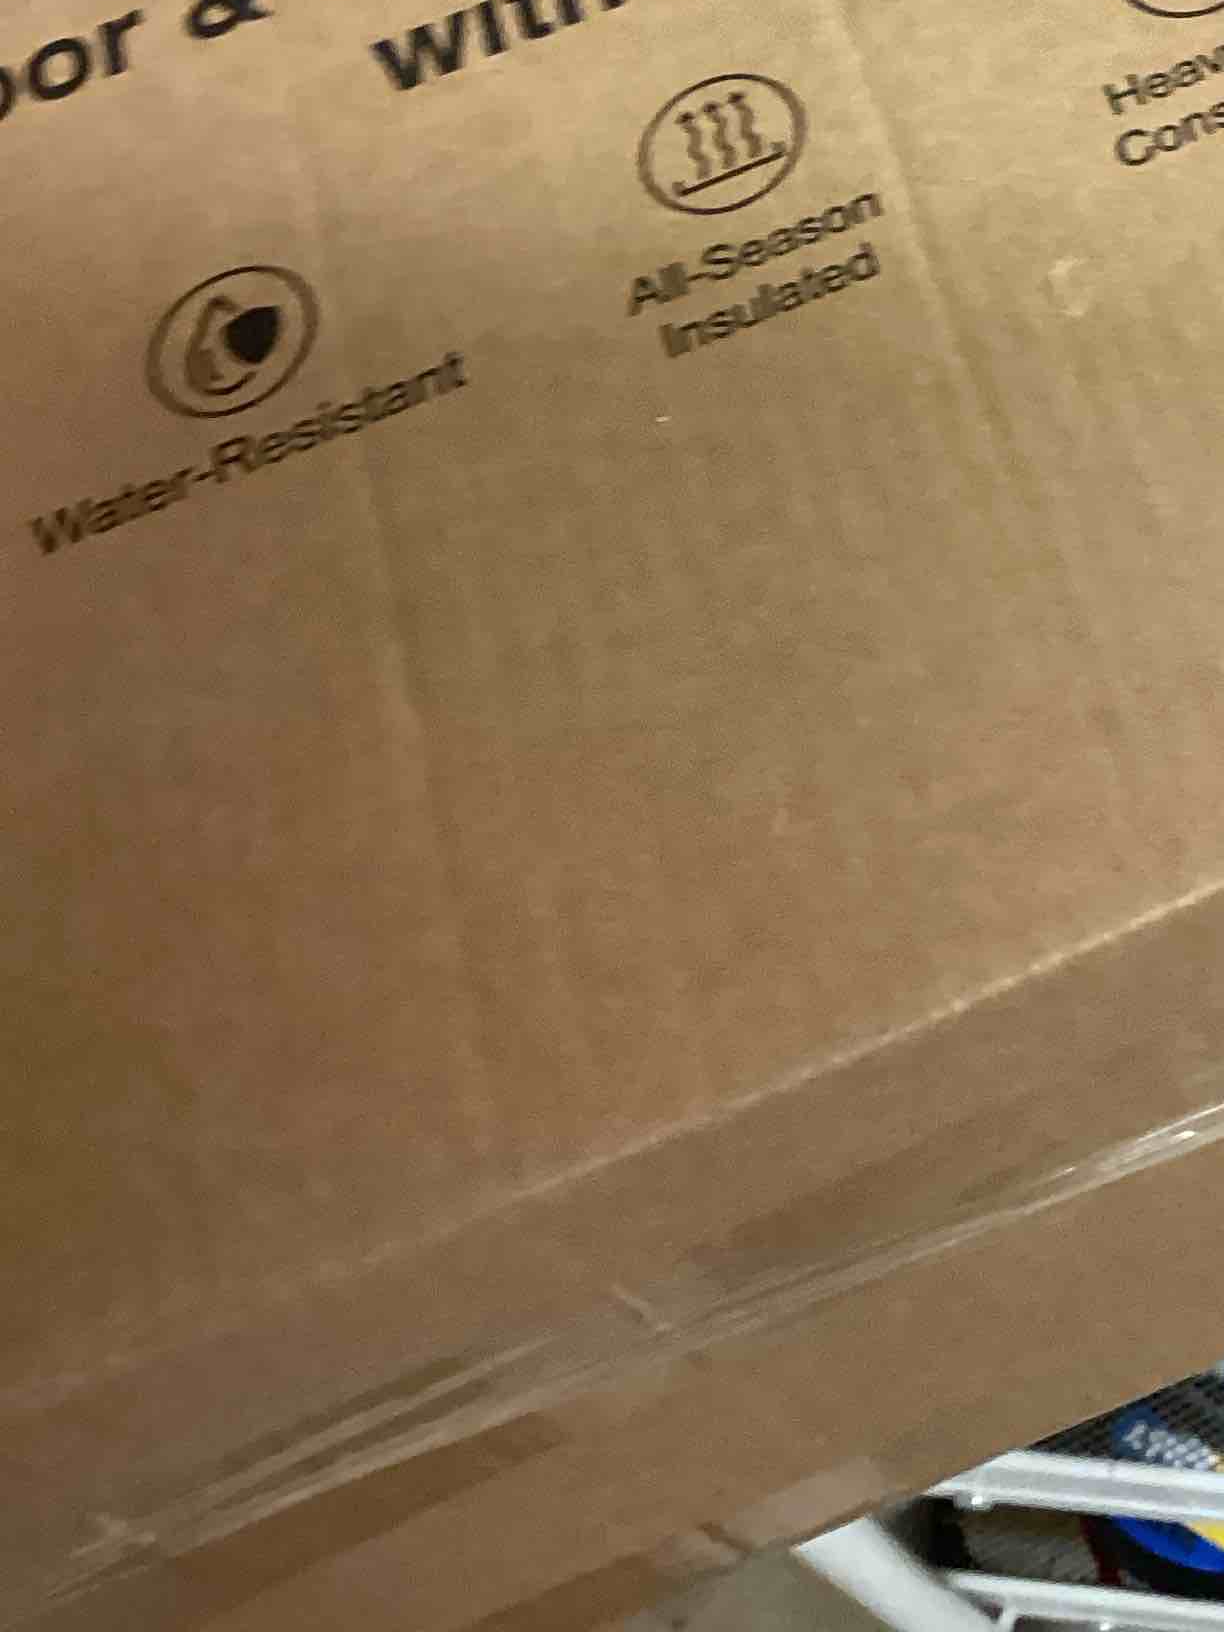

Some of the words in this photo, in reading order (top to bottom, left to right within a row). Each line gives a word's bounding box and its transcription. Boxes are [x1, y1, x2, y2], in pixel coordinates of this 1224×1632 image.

[0, 9, 143, 123] or
[627, 190, 885, 316] All-Season
[659, 243, 882, 358] Insulated
[26, 352, 468, 556] Water-Resistant
